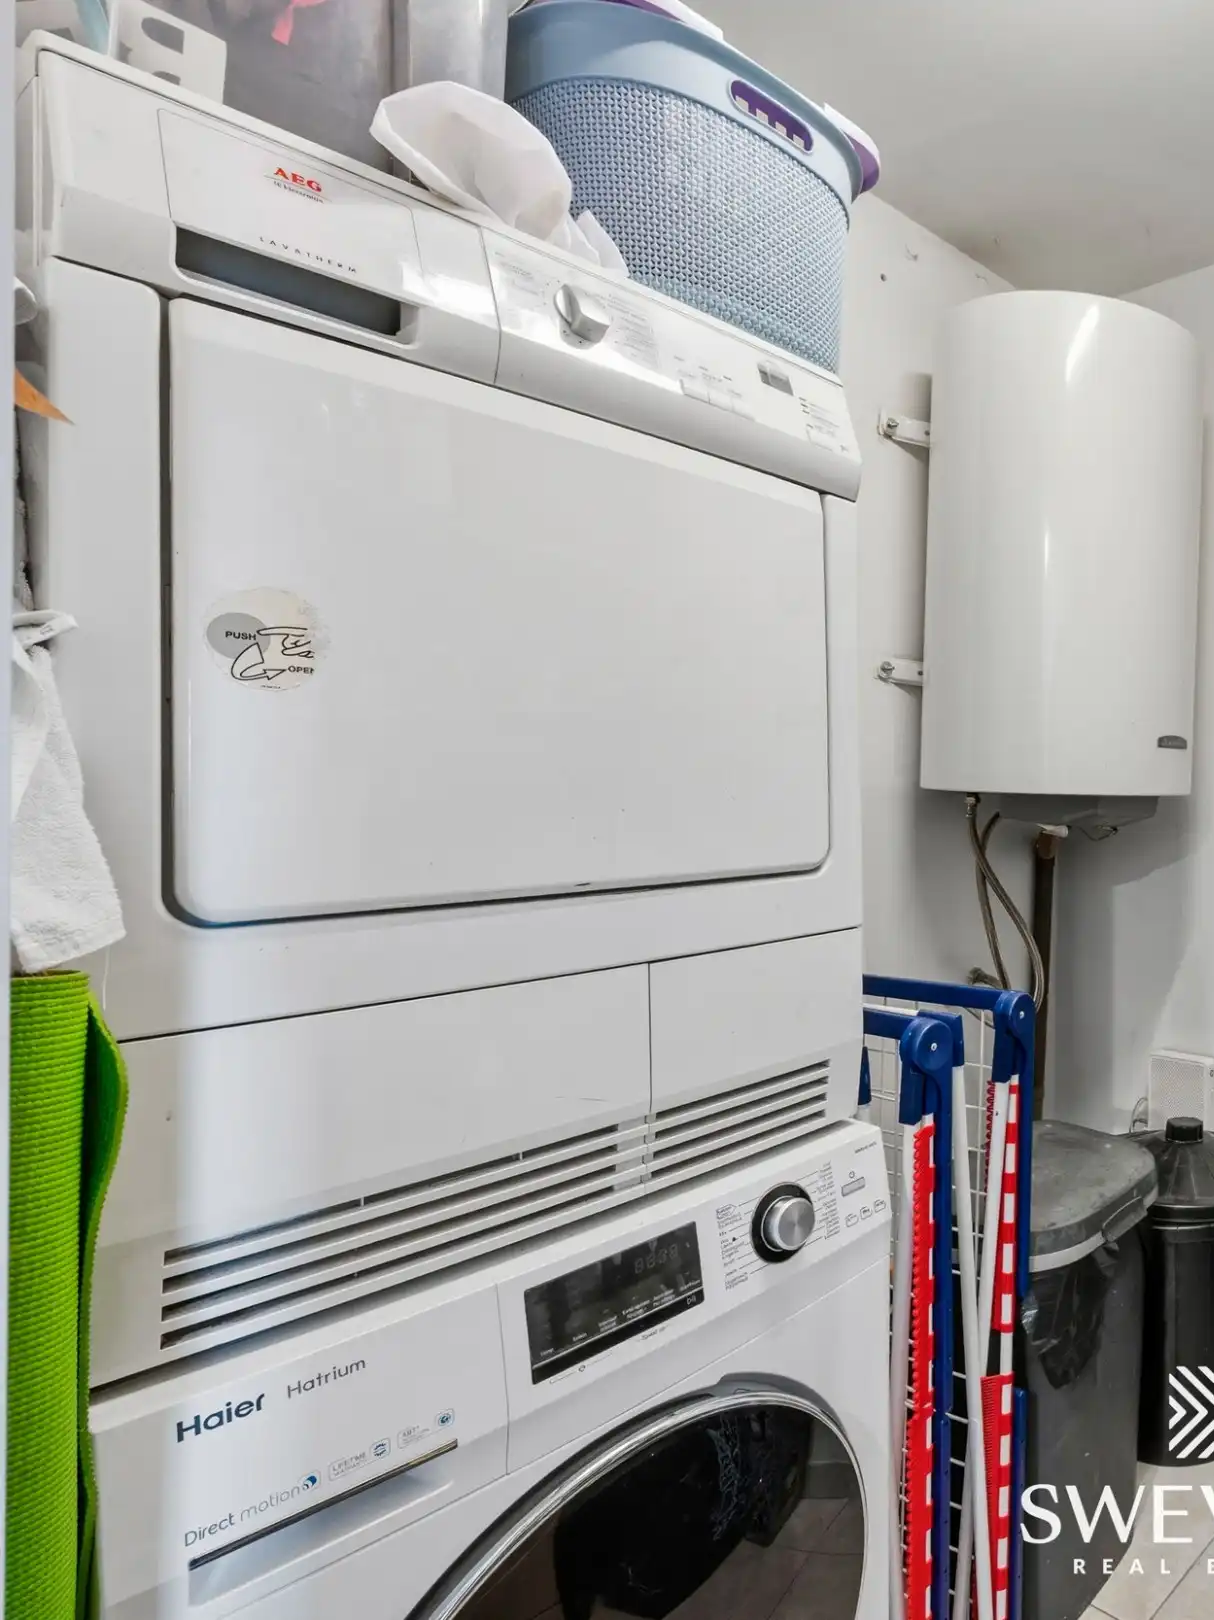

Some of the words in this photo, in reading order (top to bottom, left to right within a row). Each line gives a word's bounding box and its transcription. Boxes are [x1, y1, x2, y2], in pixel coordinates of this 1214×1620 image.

[274, 167, 322, 192] AEG
[259, 236, 357, 274] LAVATHERM
[225, 630, 257, 641] PUSH
[176, 1393, 265, 1443] Haier
[287, 1359, 367, 1400] Hatrium
[184, 1513, 236, 1548] Direct
[240, 1485, 300, 1522] motion
